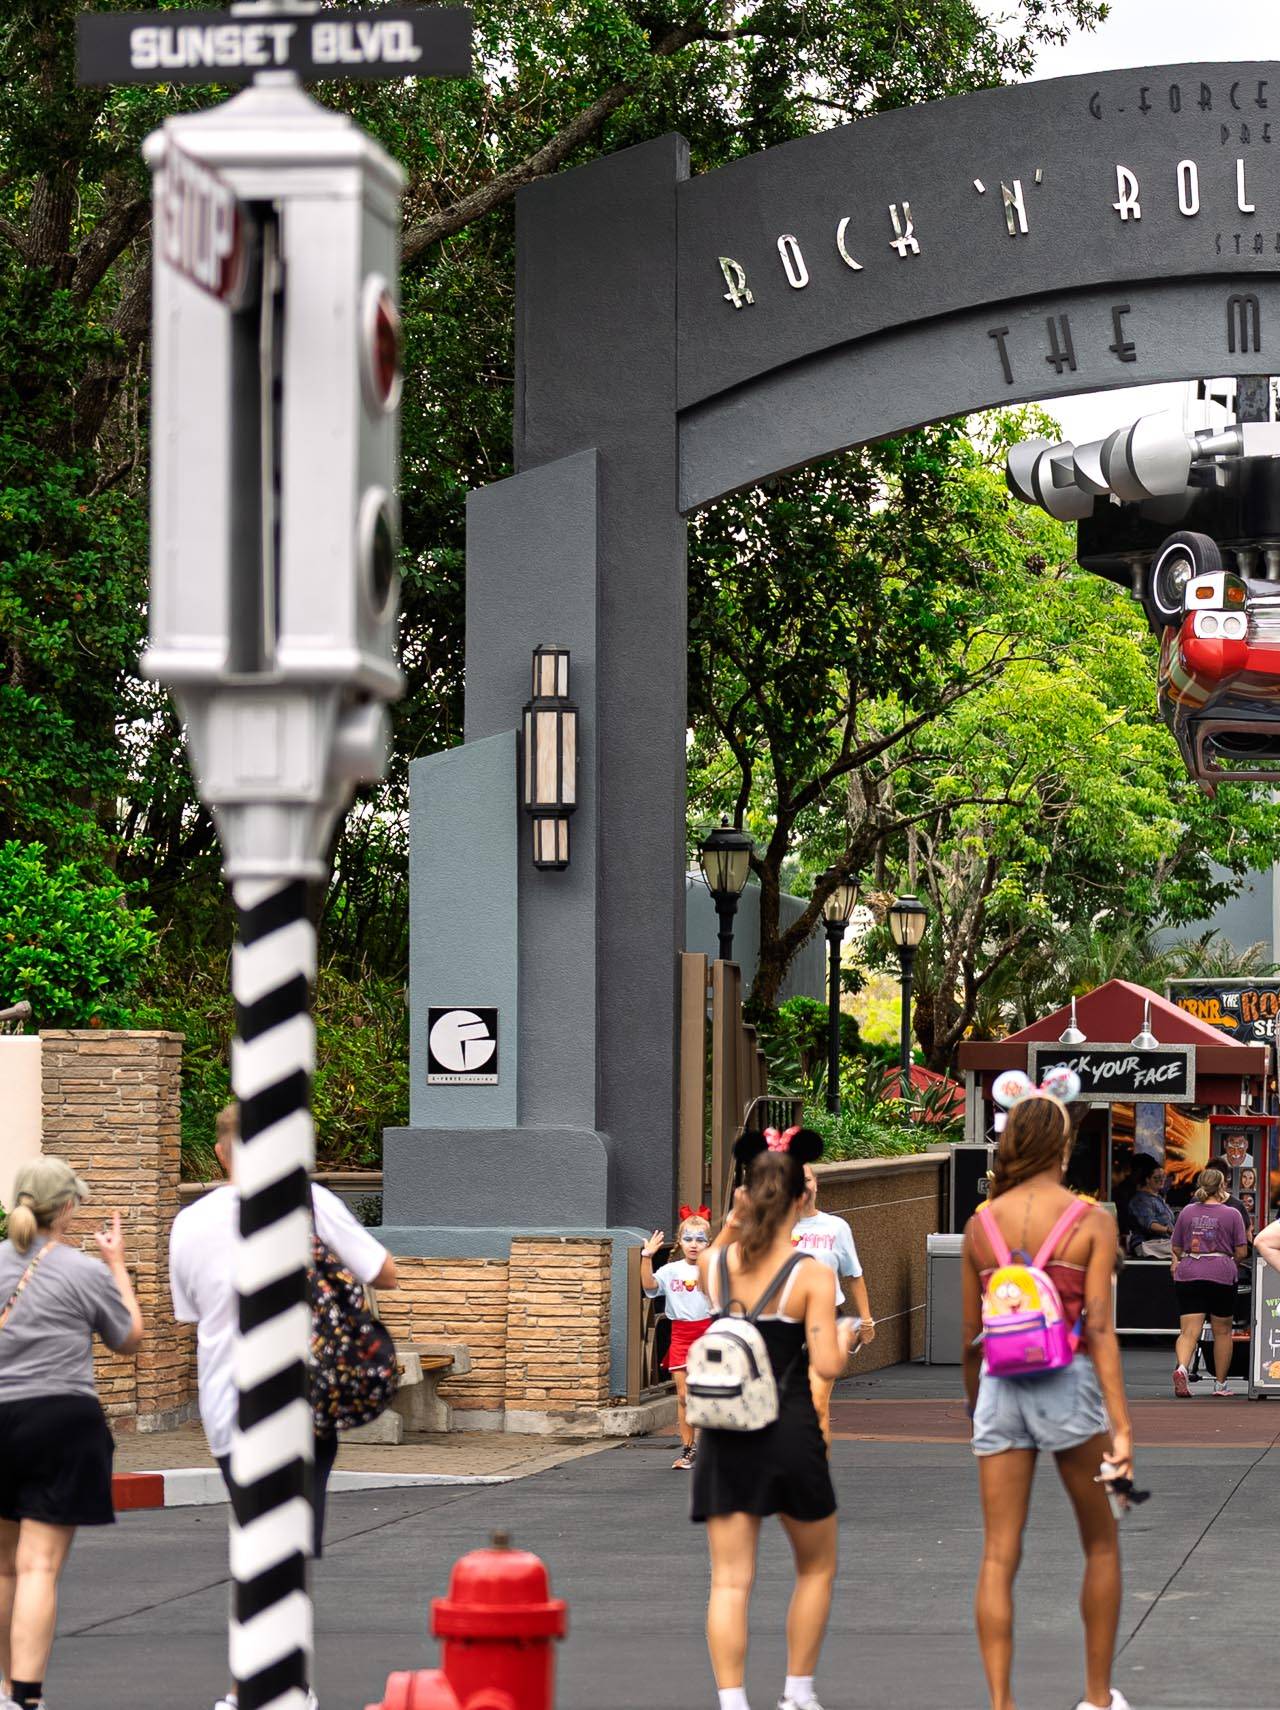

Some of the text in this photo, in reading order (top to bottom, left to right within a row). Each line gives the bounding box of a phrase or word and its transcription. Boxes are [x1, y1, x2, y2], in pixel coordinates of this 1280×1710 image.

[130, 20, 422, 68] SUNSET BLVD.
[1089, 80, 1268, 120] G-FORCE
[718, 201, 921, 309] ROCK
[988, 304, 1137, 384] THE
[1222, 994, 1240, 1008] THE
[1092, 1056, 1140, 1085] YOUR
[1133, 1062, 1184, 1089] FACE
